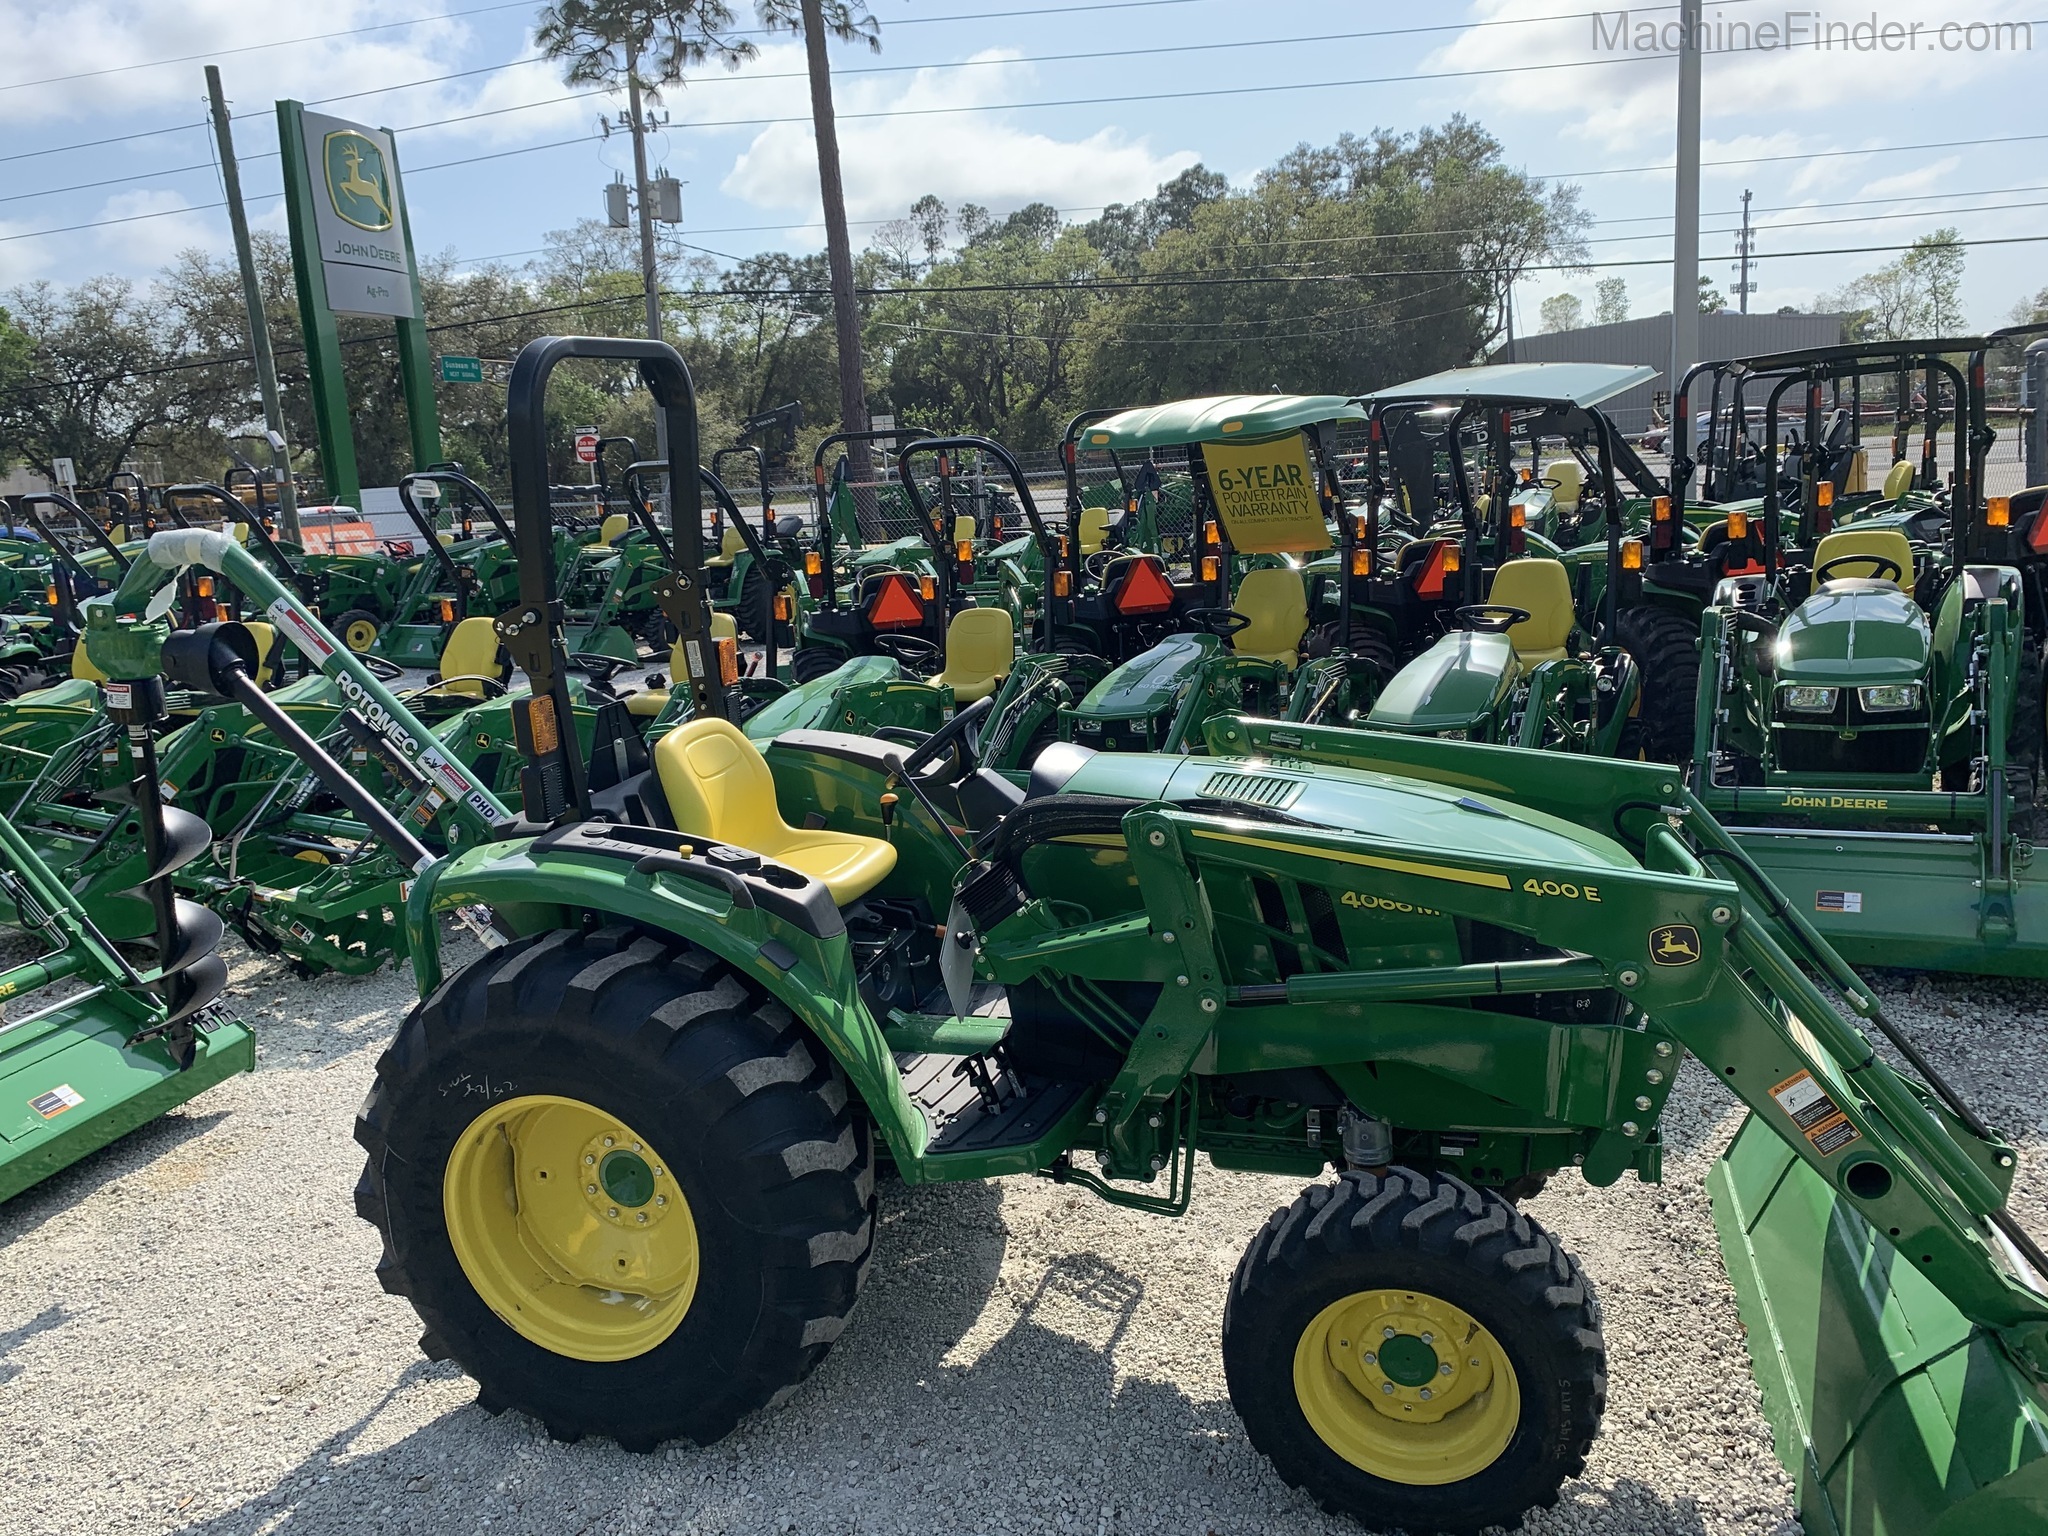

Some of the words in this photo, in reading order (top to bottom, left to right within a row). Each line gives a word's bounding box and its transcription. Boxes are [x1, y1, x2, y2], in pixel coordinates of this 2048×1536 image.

[334, 239, 369, 258] JOHN
[369, 245, 402, 264] DEERE
[366, 285, 390, 298] Ag-Pro
[755, 417, 777, 427] VOLVO
[1217, 463, 1304, 492] 6-YEAR
[1222, 487, 1308, 504] POWERTRAIN
[1226, 501, 1310, 518] WARRANTY
[334, 669, 419, 757] ROTOMEC
[448, 769, 467, 789] DANGER
[470, 794, 496, 819] PHD
[1781, 795, 1827, 808] JOHN
[1831, 796, 1888, 810] DEERE
[1522, 878, 1580, 899] 400
[1583, 886, 1602, 902] E
[1779, 1072, 1806, 1090] WARNING
[1816, 1116, 1844, 1133] WARNING
